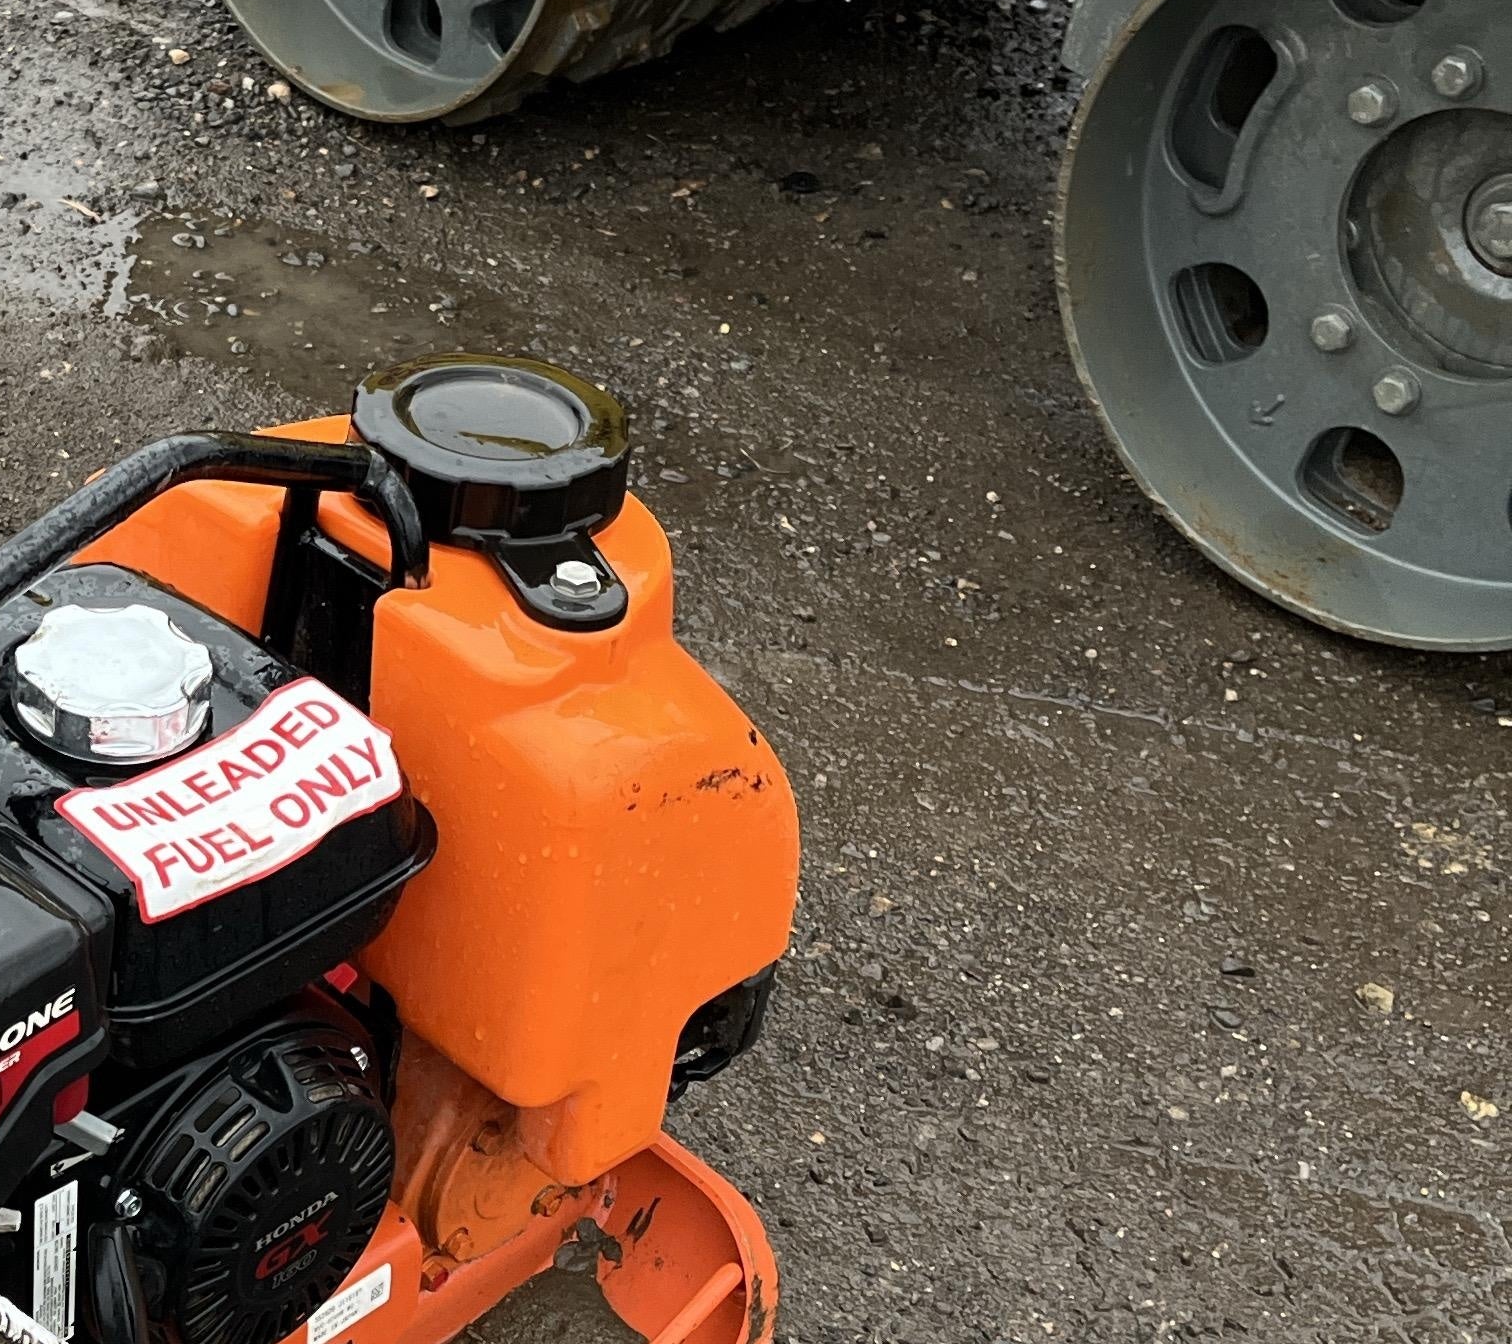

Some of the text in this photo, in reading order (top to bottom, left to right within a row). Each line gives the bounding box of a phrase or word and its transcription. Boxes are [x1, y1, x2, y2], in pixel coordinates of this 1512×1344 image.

[92, 699, 341, 832] UNLEADED
[142, 737, 384, 889] FUEL ONLY
[255, 1191, 339, 1252] HONDA
[256, 1207, 334, 1280] GX
